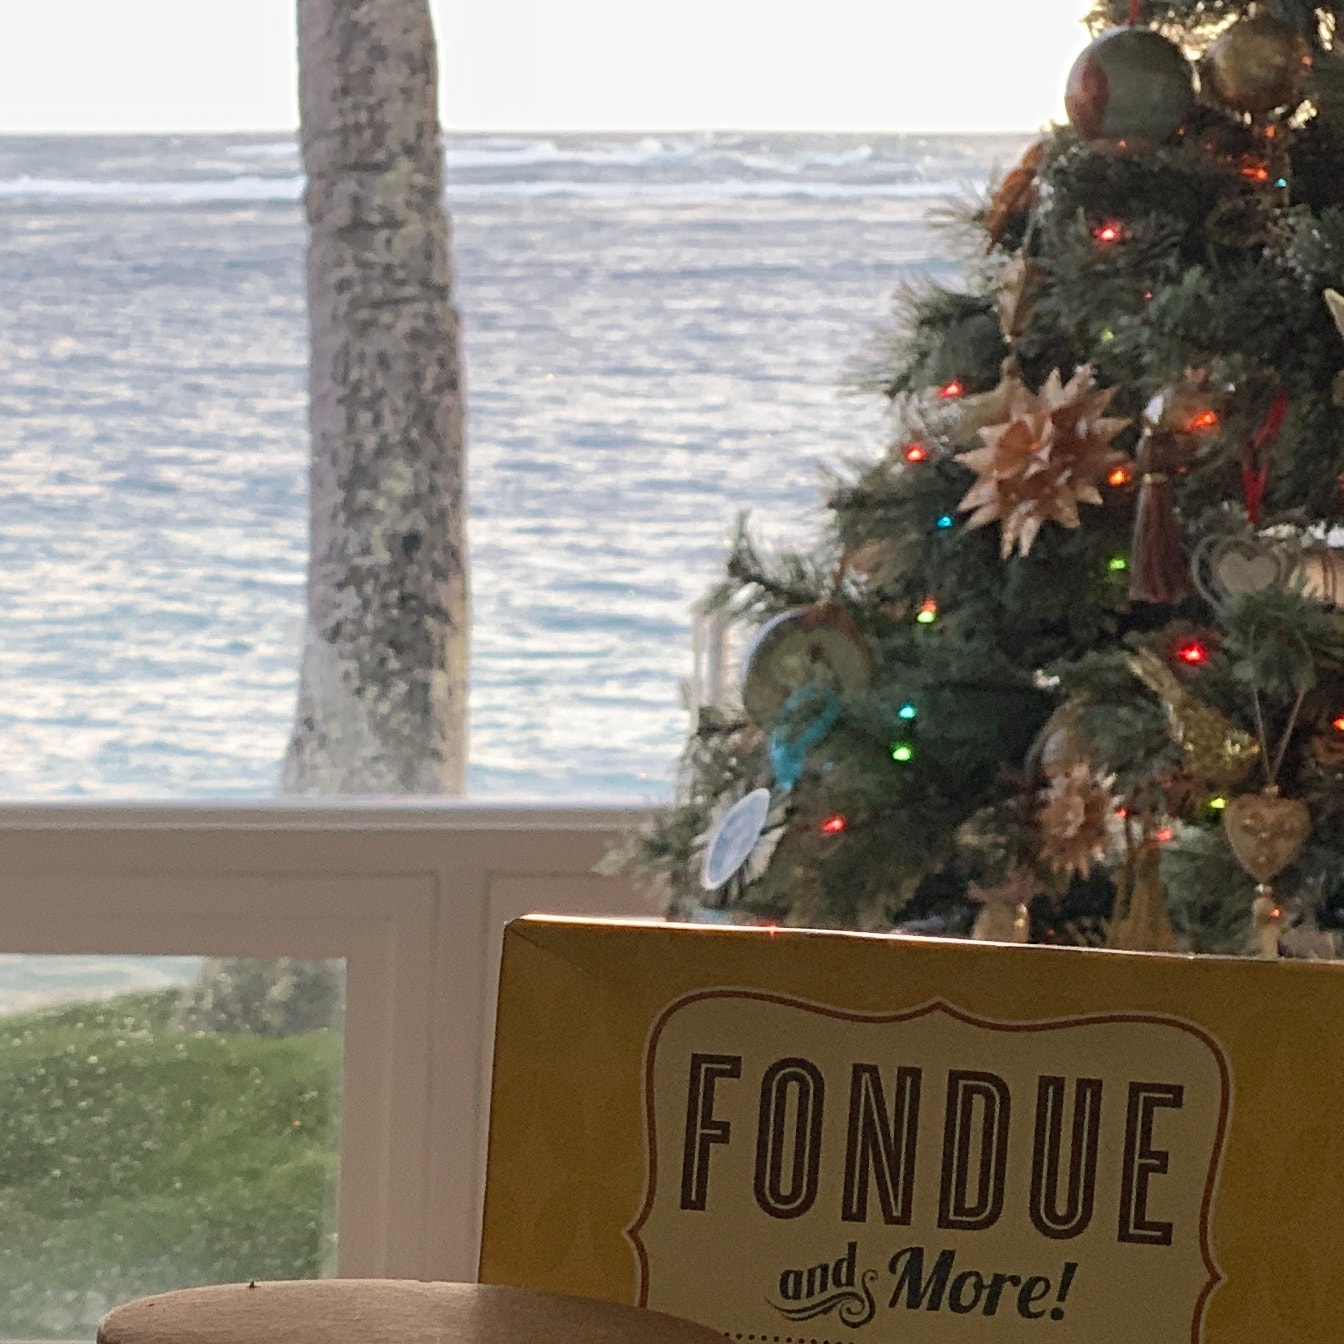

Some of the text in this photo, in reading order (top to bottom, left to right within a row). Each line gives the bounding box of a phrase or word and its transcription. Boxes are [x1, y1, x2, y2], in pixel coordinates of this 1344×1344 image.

[680, 1053, 1184, 1246] FONDUE
[772, 1241, 1079, 1322] and More!
